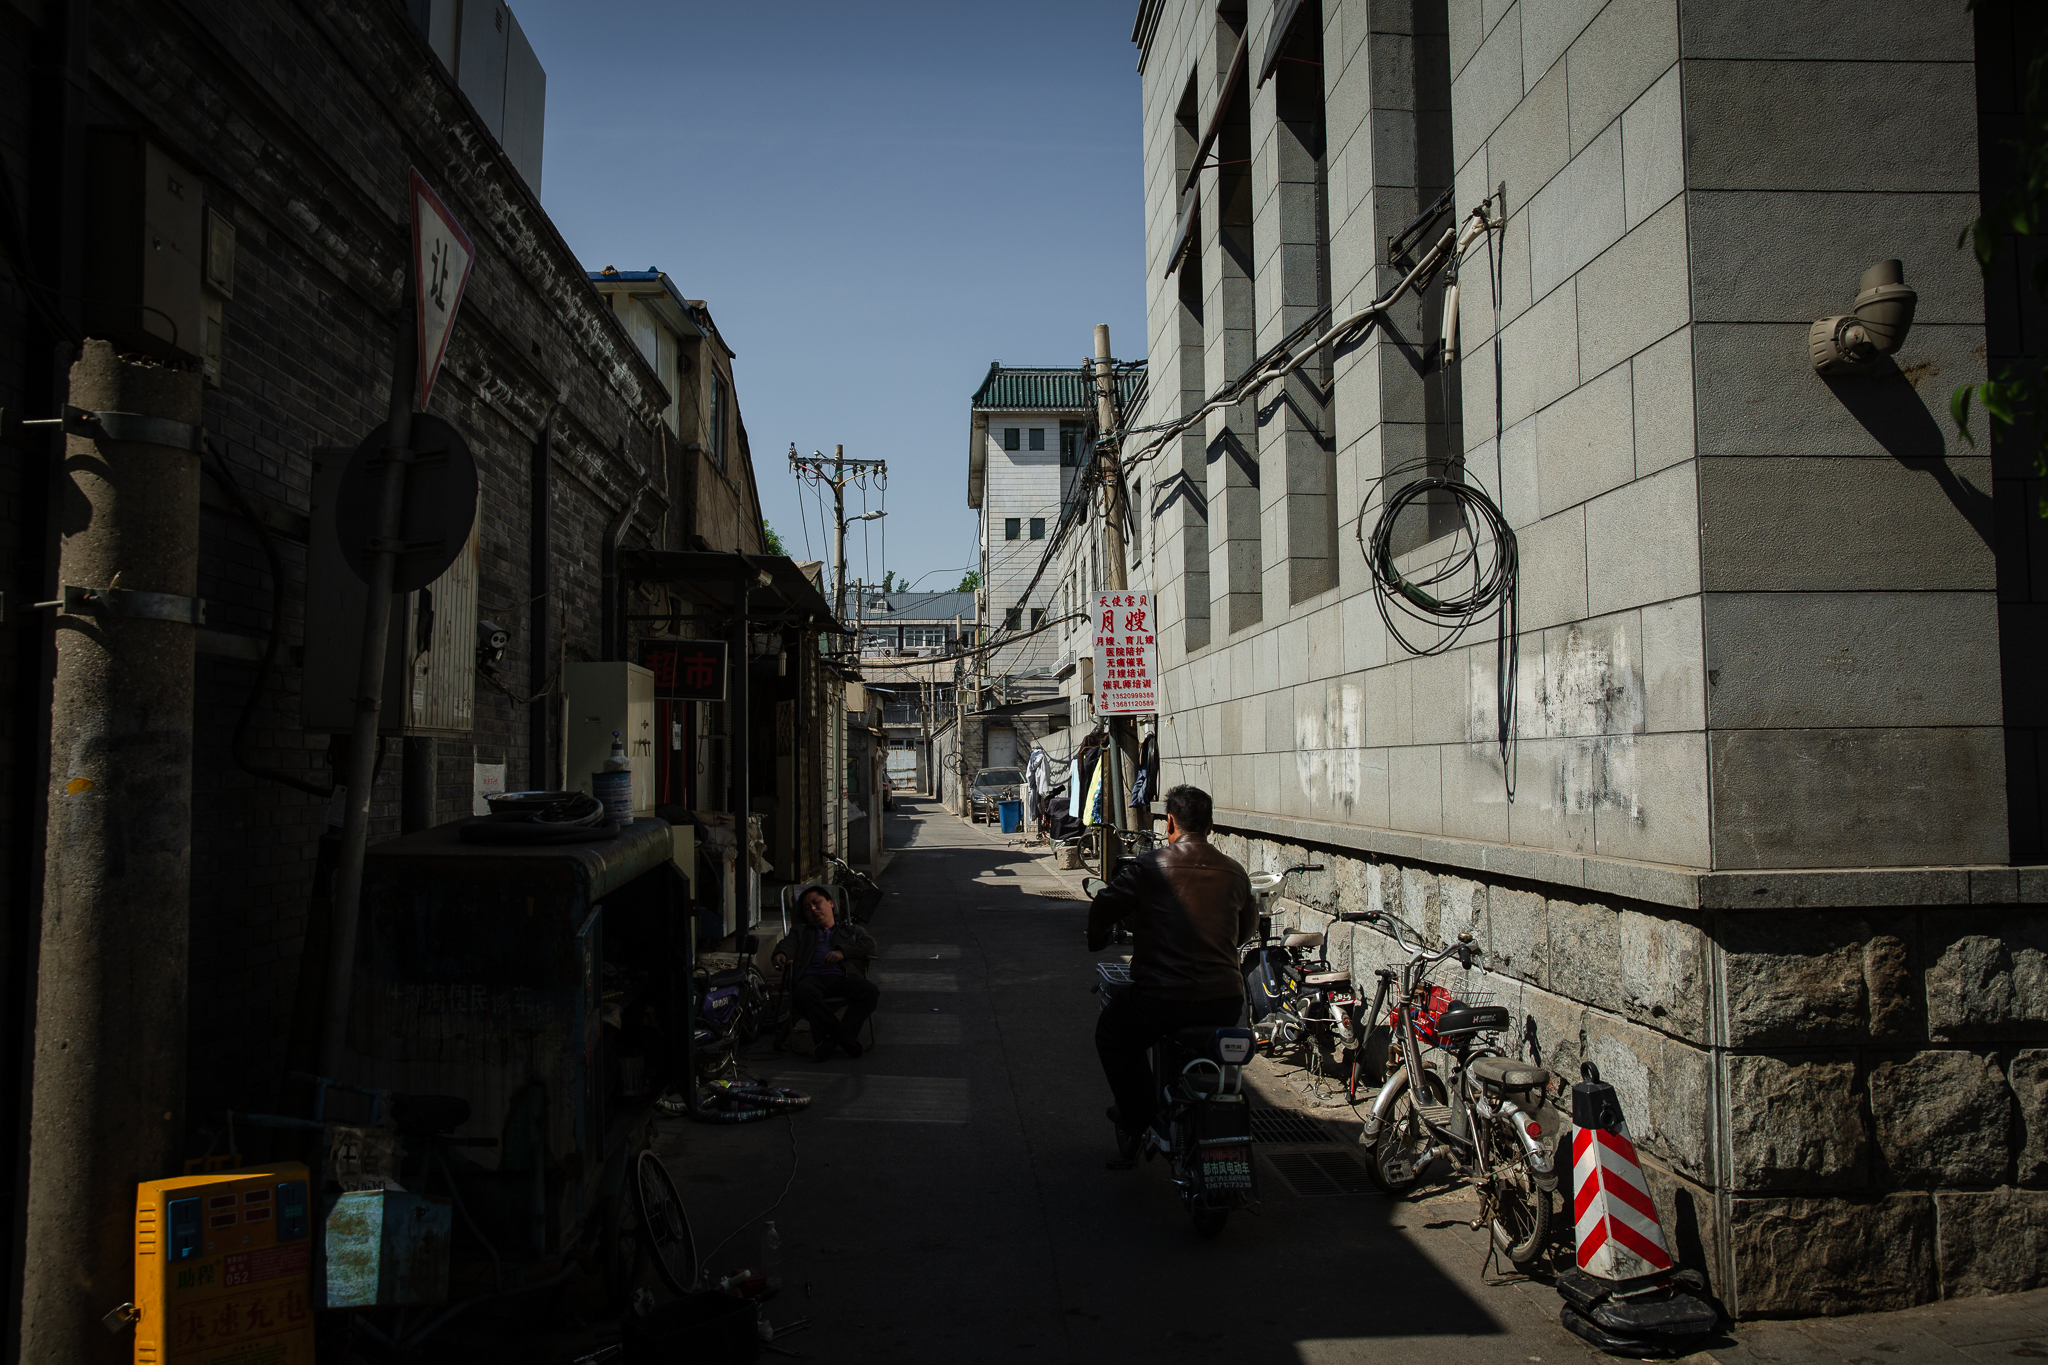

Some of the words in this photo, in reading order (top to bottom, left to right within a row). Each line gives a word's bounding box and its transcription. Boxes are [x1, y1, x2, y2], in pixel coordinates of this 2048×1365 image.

[430, 237, 449, 313] 让
[1099, 594, 1148, 608] 天使宝贝
[1100, 608, 1149, 634] 月嫂
[1095, 634, 1154, 646] 月嫂、育儿嫂
[1105, 646, 1145, 657] 医院陪护
[645, 650, 717, 690] 超市
[1106, 657, 1146, 668] 无痛催乳
[1106, 668, 1146, 679] 月嫂培训
[1102, 679, 1152, 690] 催乳师培训
[1099, 691, 1109, 710] 电话
[1202, 1161, 1250, 1176] 都市风电动车
[177, 1263, 216, 1290] 助程
[226, 1271, 249, 1286] 052
[173, 1289, 307, 1349] 快速充电
